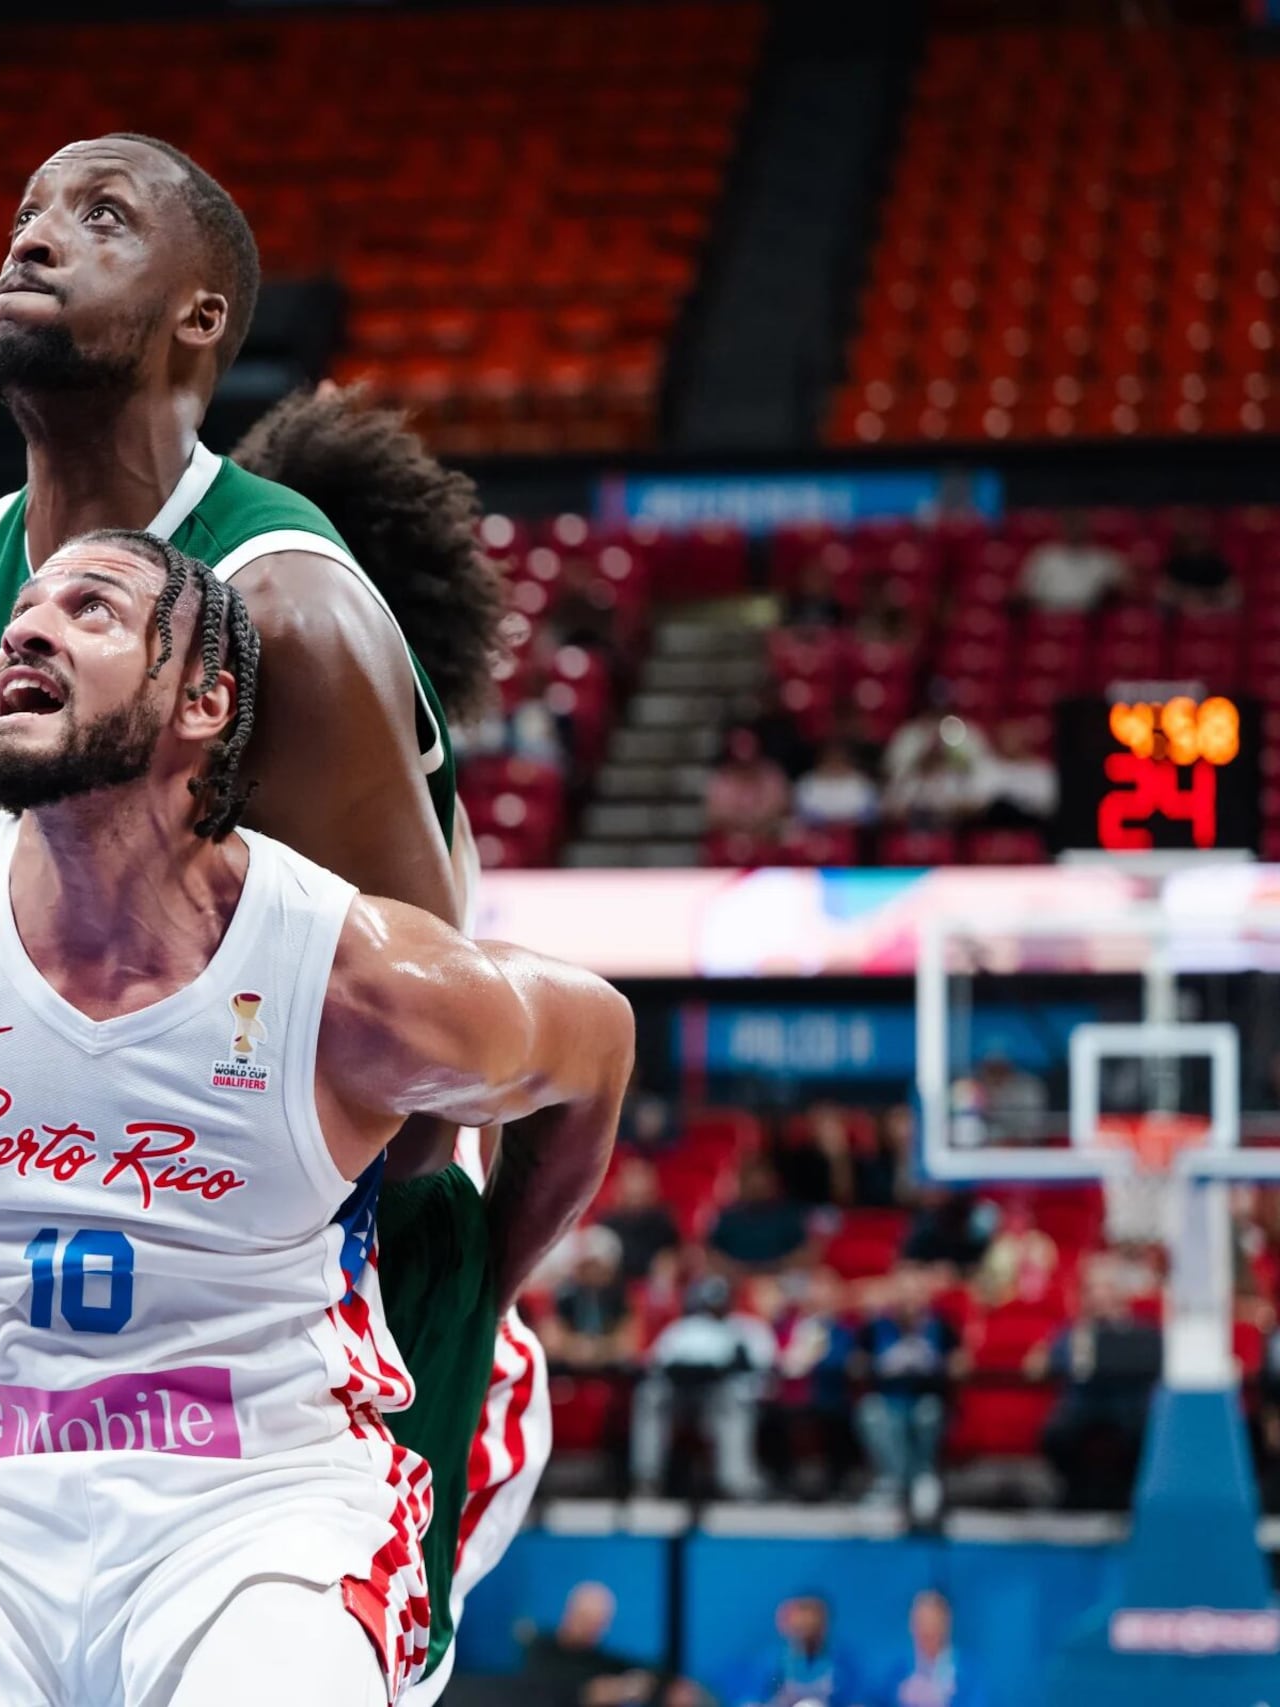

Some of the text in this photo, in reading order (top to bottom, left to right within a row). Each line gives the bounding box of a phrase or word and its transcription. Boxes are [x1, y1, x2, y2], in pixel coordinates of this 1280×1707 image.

[1097, 752, 1217, 857] 24
[212, 1075, 267, 1090] QUALIFIERS
[214, 1067, 268, 1079] WORLD CUP
[102, 1121, 246, 1210] Rico
[23, 1227, 135, 1335] 10
